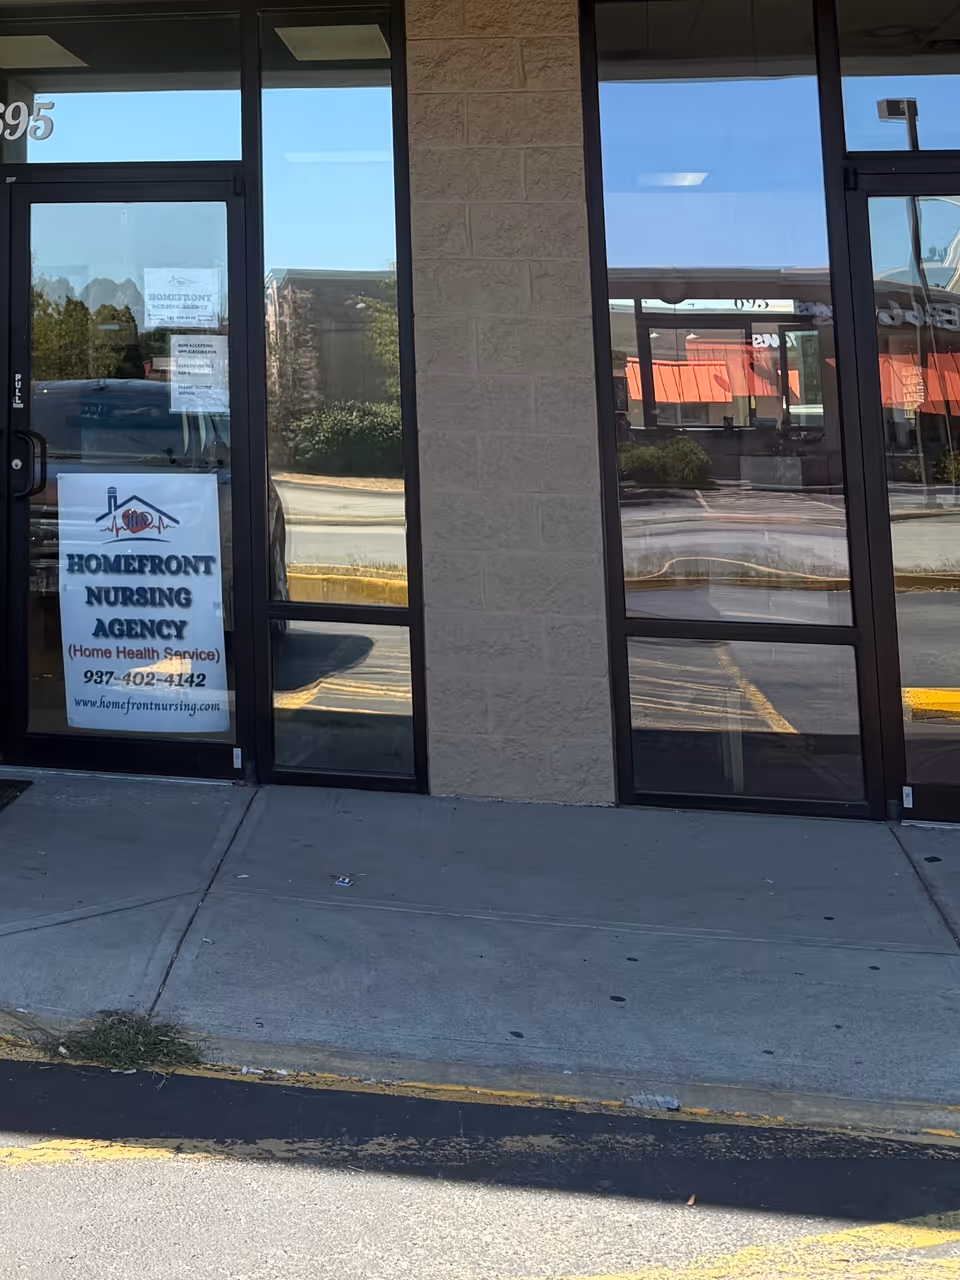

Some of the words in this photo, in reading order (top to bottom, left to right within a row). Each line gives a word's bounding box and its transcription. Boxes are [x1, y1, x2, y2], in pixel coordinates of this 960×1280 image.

[66, 554, 216, 576] HOMEFRONT
[85, 586, 193, 609] NURSING
[92, 618, 189, 640] AGENCY
[68, 644, 112, 660] (Home
[116, 645, 160, 660] Health
[164, 646, 220, 664] Service)
[83, 669, 207, 688] 937-402-4142
[73, 695, 220, 717] www.homefrontnursing.com
